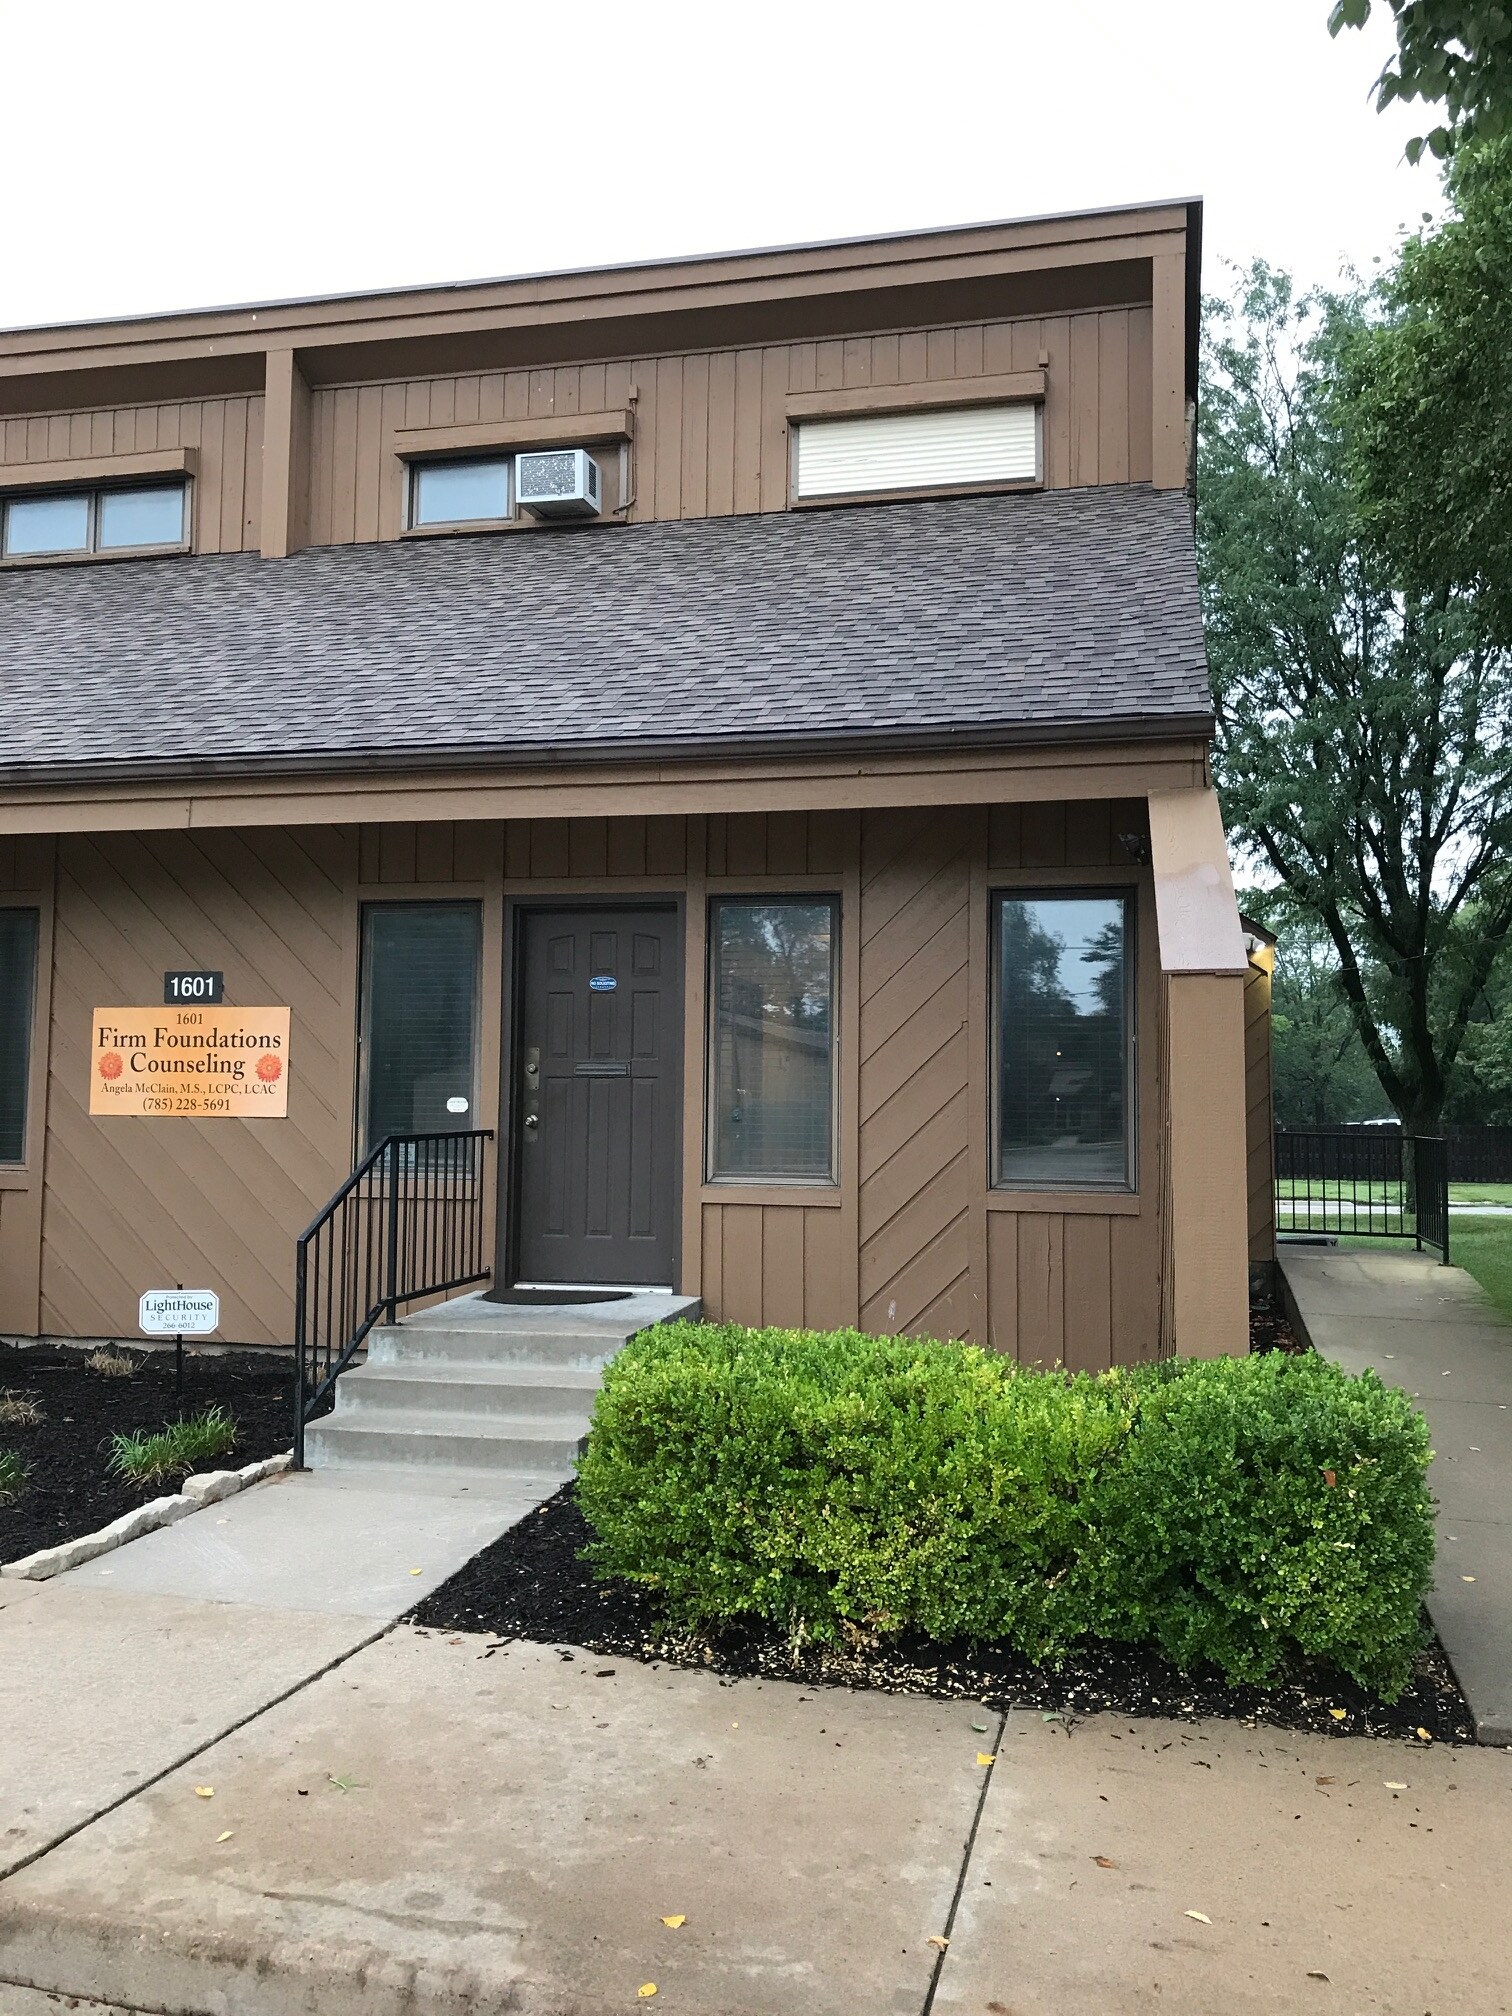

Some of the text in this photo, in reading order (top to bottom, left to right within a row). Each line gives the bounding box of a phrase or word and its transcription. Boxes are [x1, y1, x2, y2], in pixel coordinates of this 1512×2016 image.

[170, 976, 214, 997] 1601
[176, 1013, 204, 1025] 1601
[98, 1027, 281, 1048] Firm Foundations
[130, 1052, 246, 1081] Counseling
[100, 1083, 277, 1096] Angela McClain, M.S., LCPC, LCAC
[142, 1098, 231, 1112] (785) 228-5691
[145, 1299, 213, 1314] LightHouse
